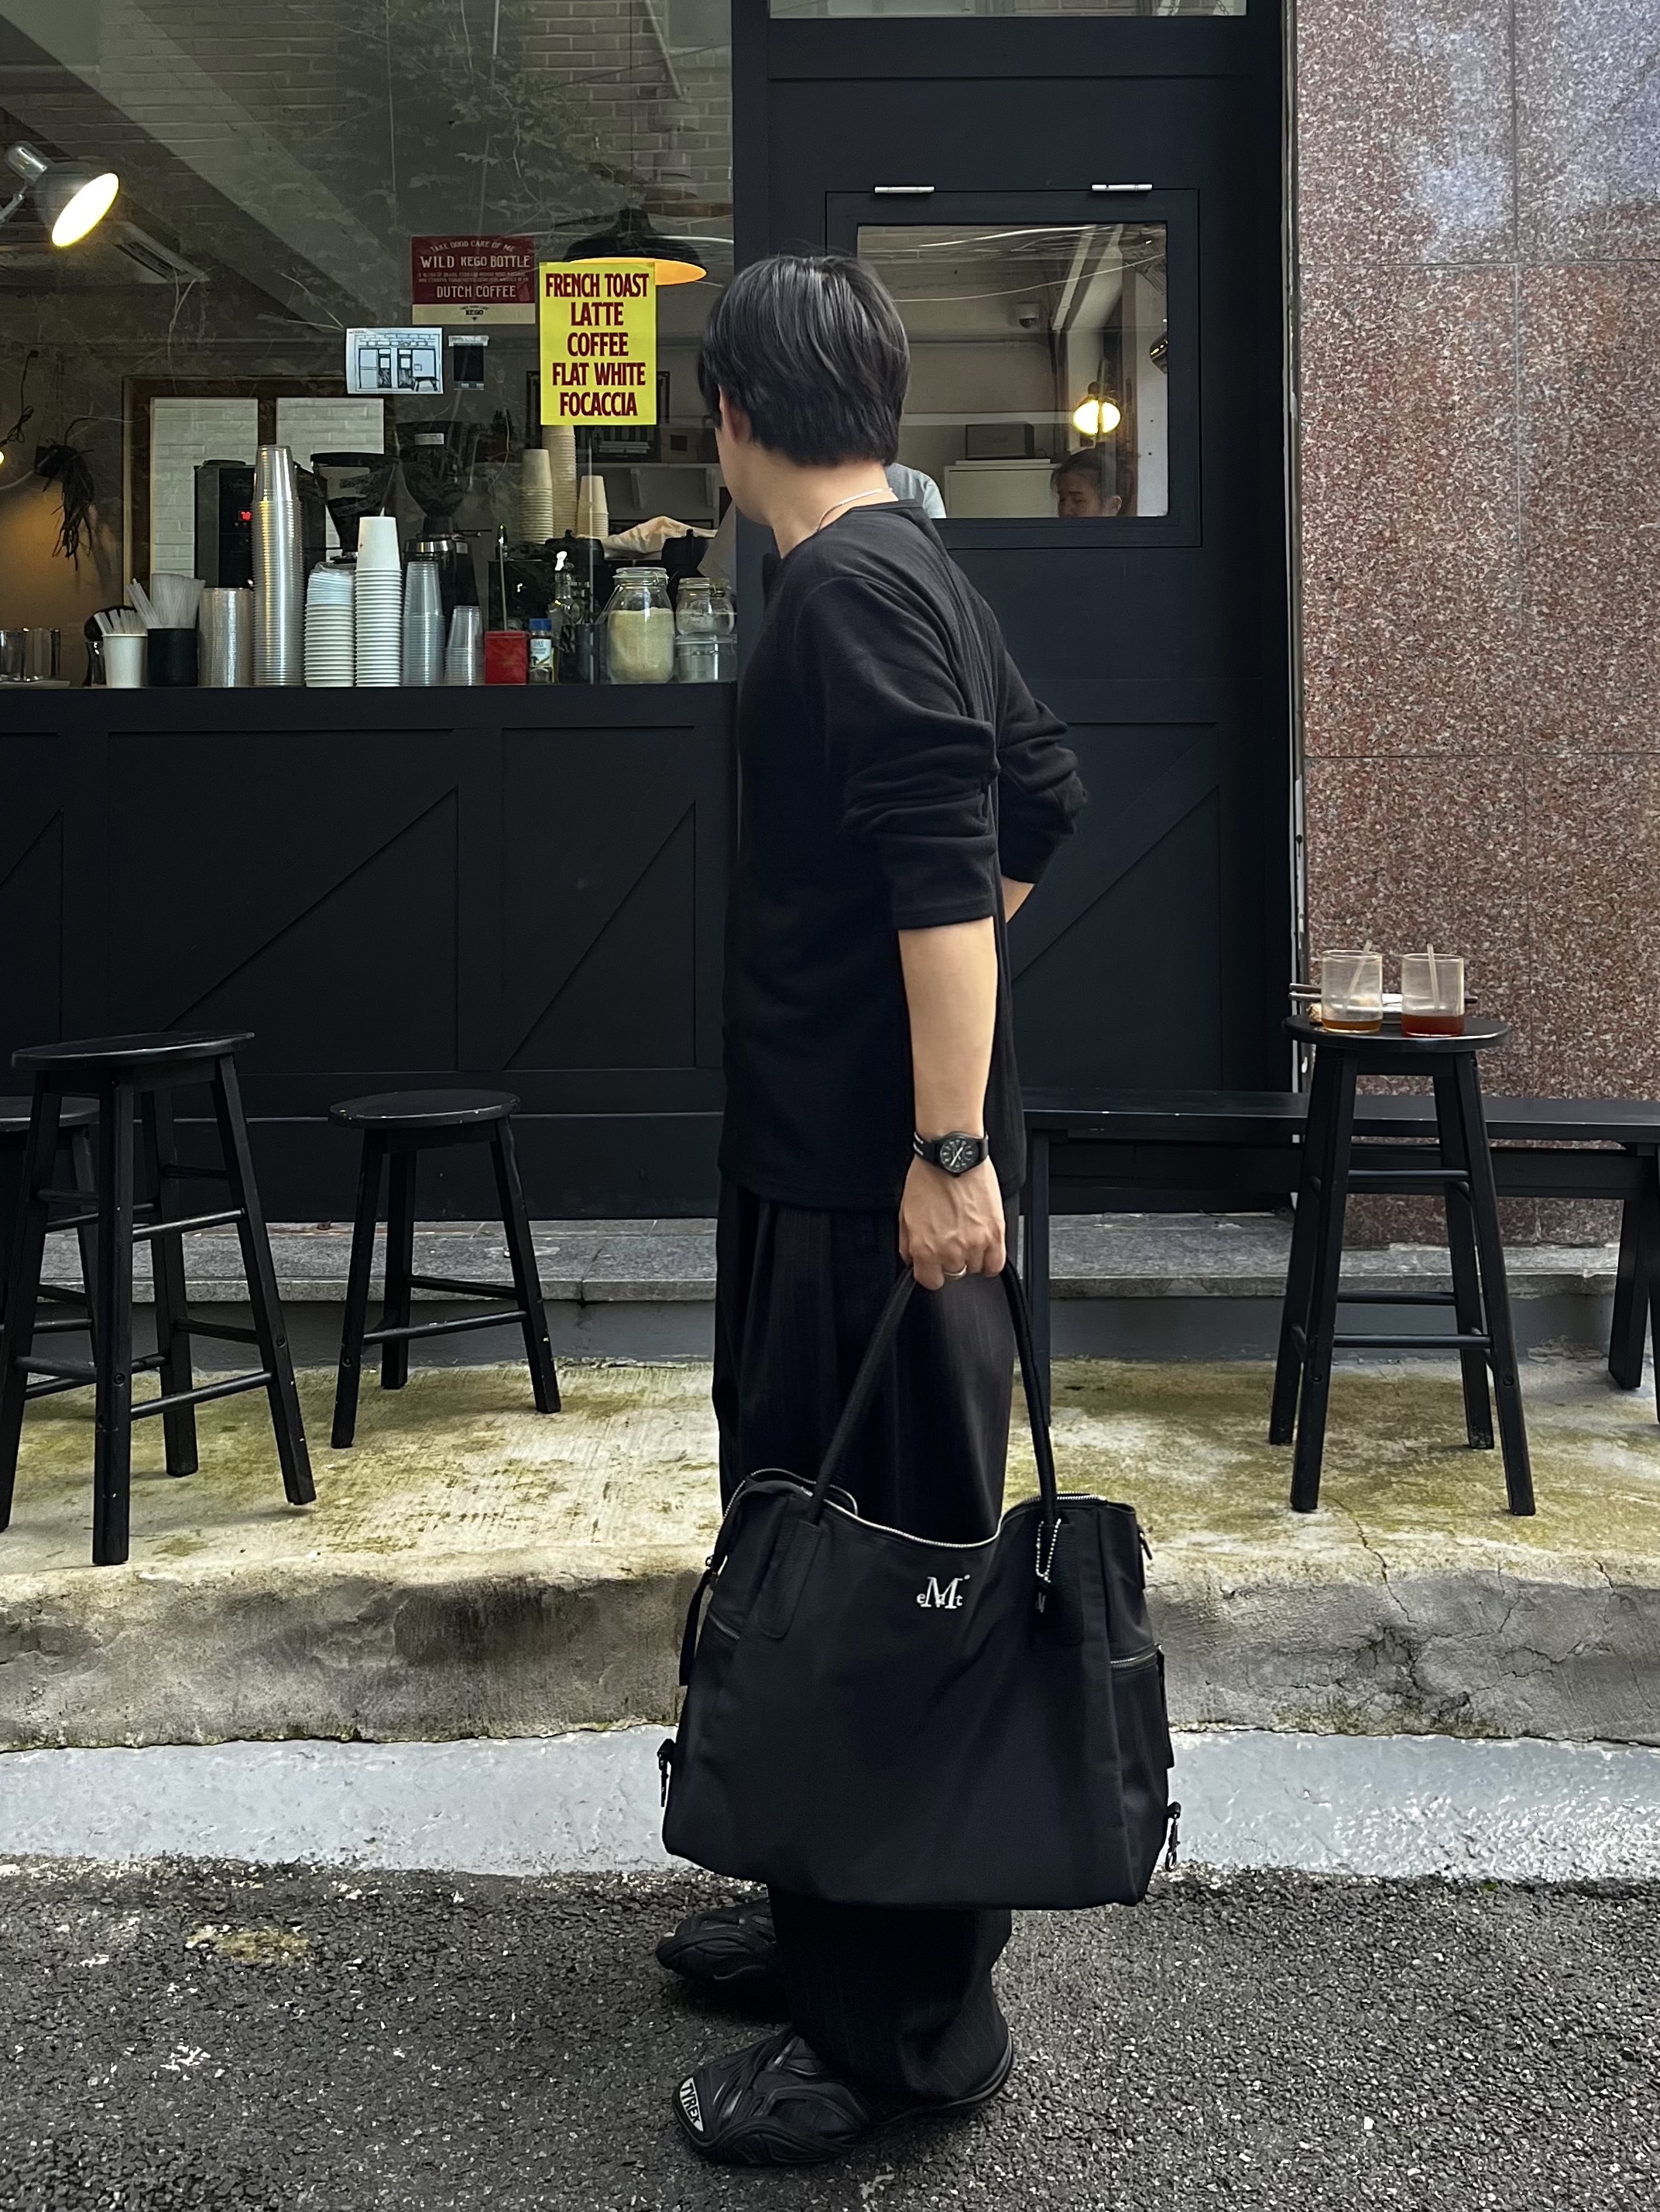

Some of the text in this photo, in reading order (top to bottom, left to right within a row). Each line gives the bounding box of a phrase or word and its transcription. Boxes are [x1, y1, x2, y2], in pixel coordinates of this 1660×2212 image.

[430, 243, 449, 252] TAKE
[503, 243, 516, 252] ME
[420, 255, 531, 268] WILD KEGO BOTTLE
[437, 285, 516, 298] DUTCH COFFEE
[545, 273, 650, 297] FRENCH TOAST
[571, 302, 624, 326] LATTE
[567, 332, 629, 357] COFFEE
[552, 362, 646, 386] FLAT WHITE
[560, 392, 638, 417] FOCACCIA
[681, 2083, 701, 2123] TYREX
